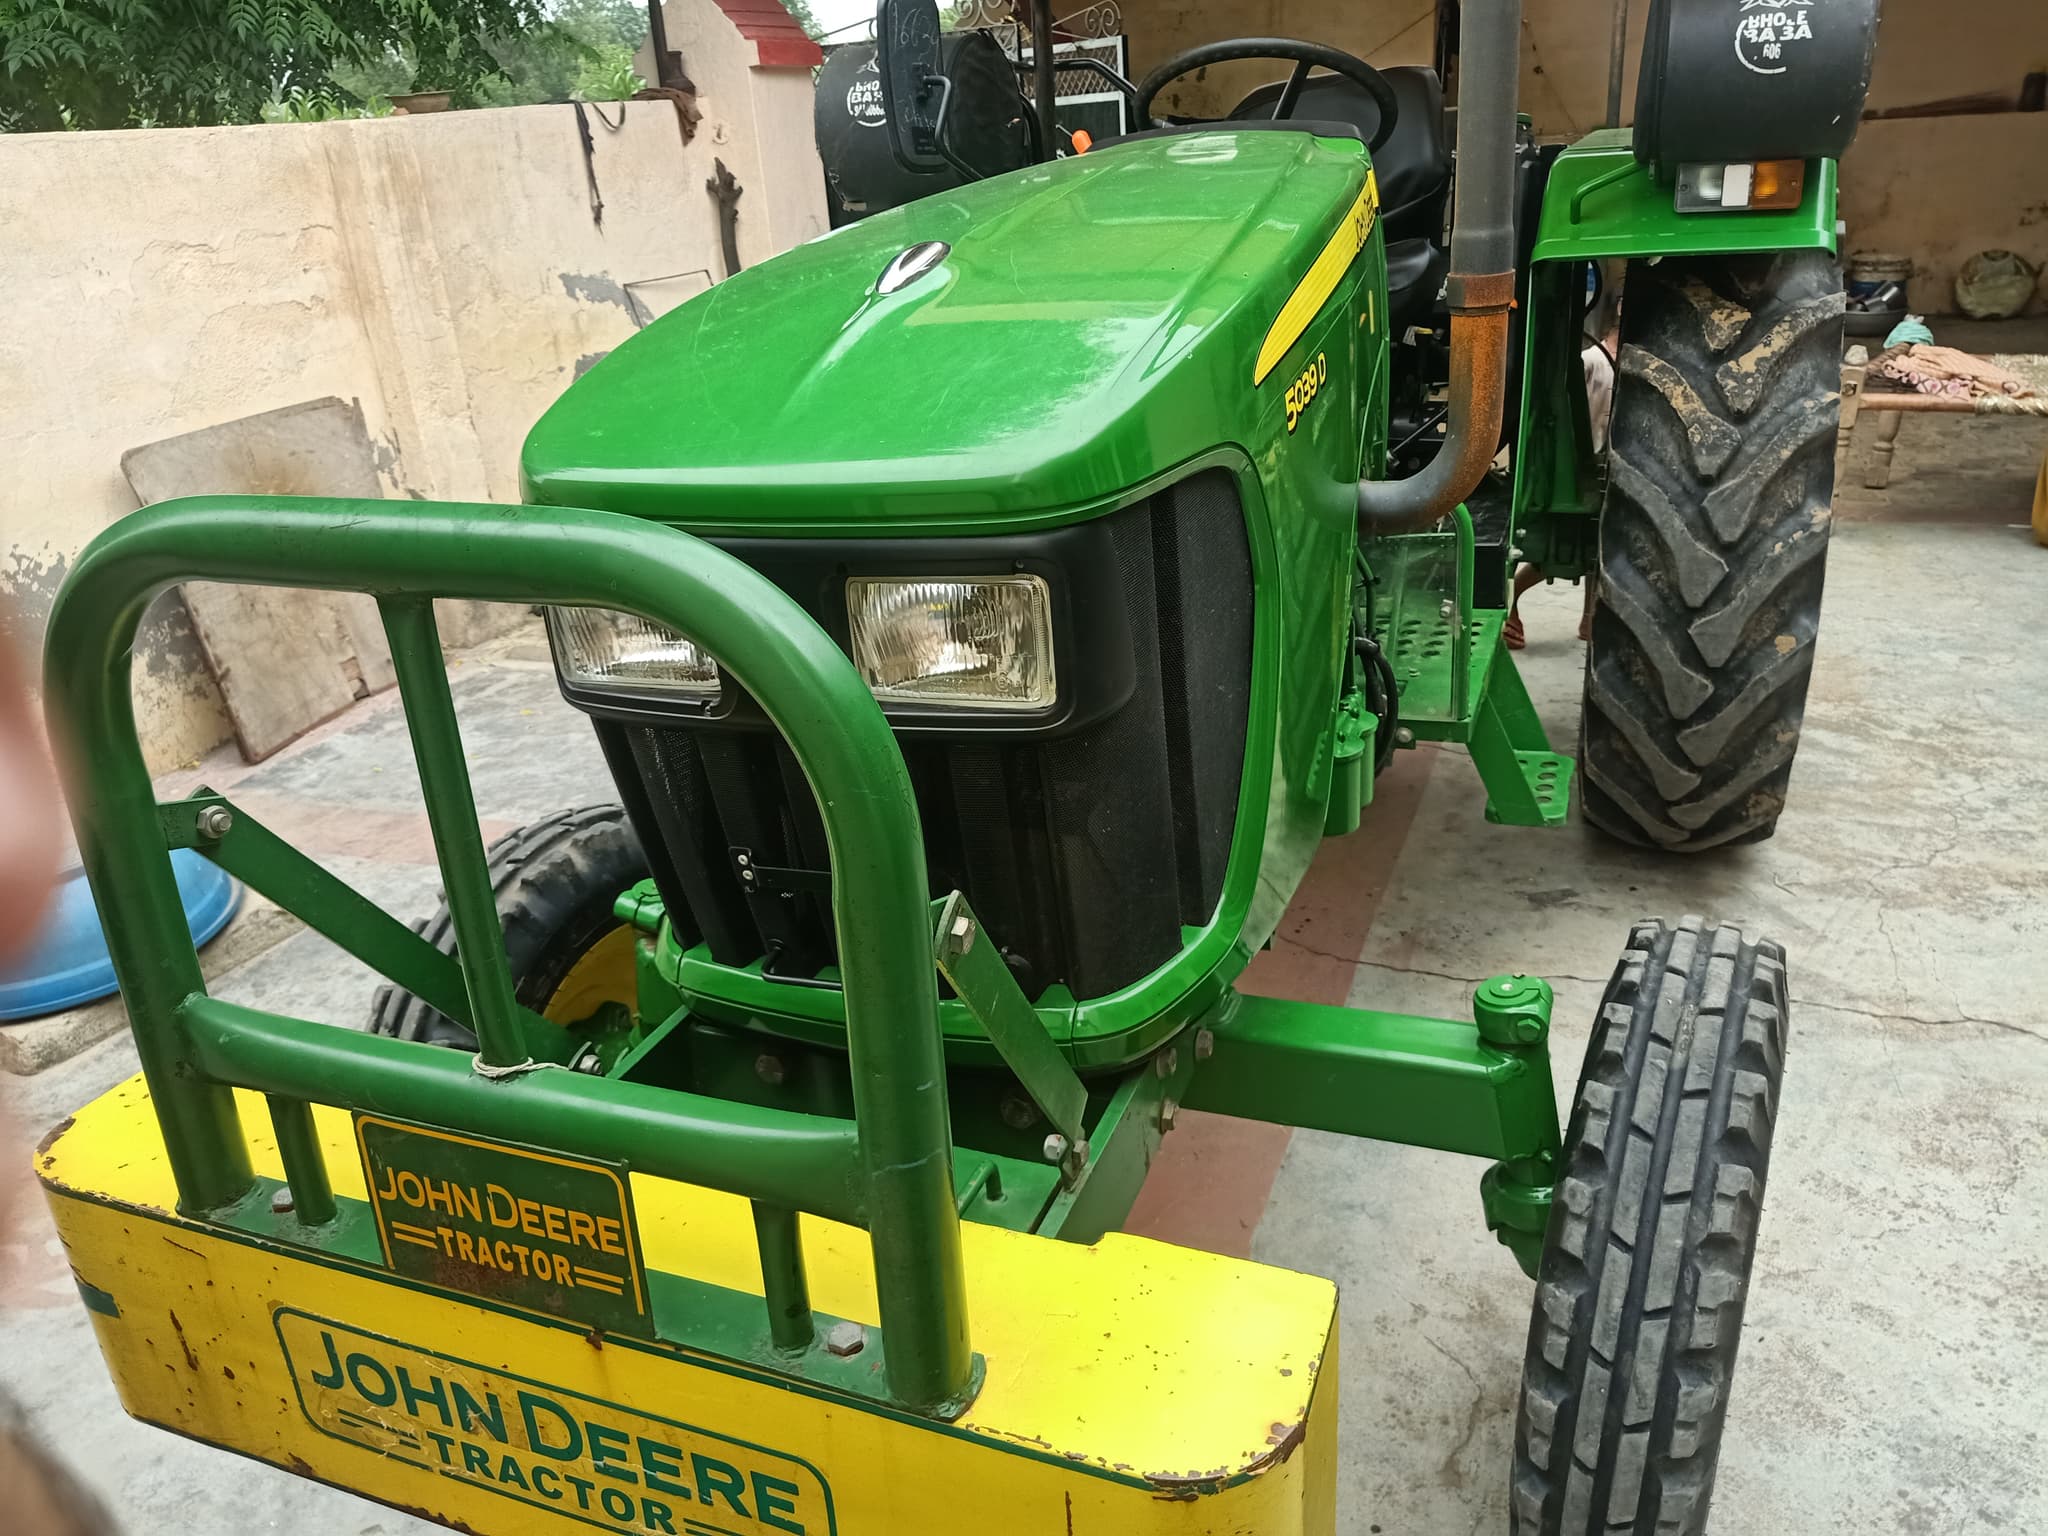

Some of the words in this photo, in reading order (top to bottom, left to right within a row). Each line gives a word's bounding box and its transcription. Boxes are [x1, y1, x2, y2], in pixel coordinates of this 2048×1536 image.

[1285, 363, 1317, 432] 5039
[1318, 351, 1327, 386] D
[379, 1166, 483, 1222] JOHN
[486, 1183, 625, 1256] DEERE
[437, 1226, 575, 1287] TRACTOR
[312, 1331, 508, 1443] JOHN
[517, 1390, 805, 1536] DEERE
[426, 1431, 676, 1535] TRACTOR
